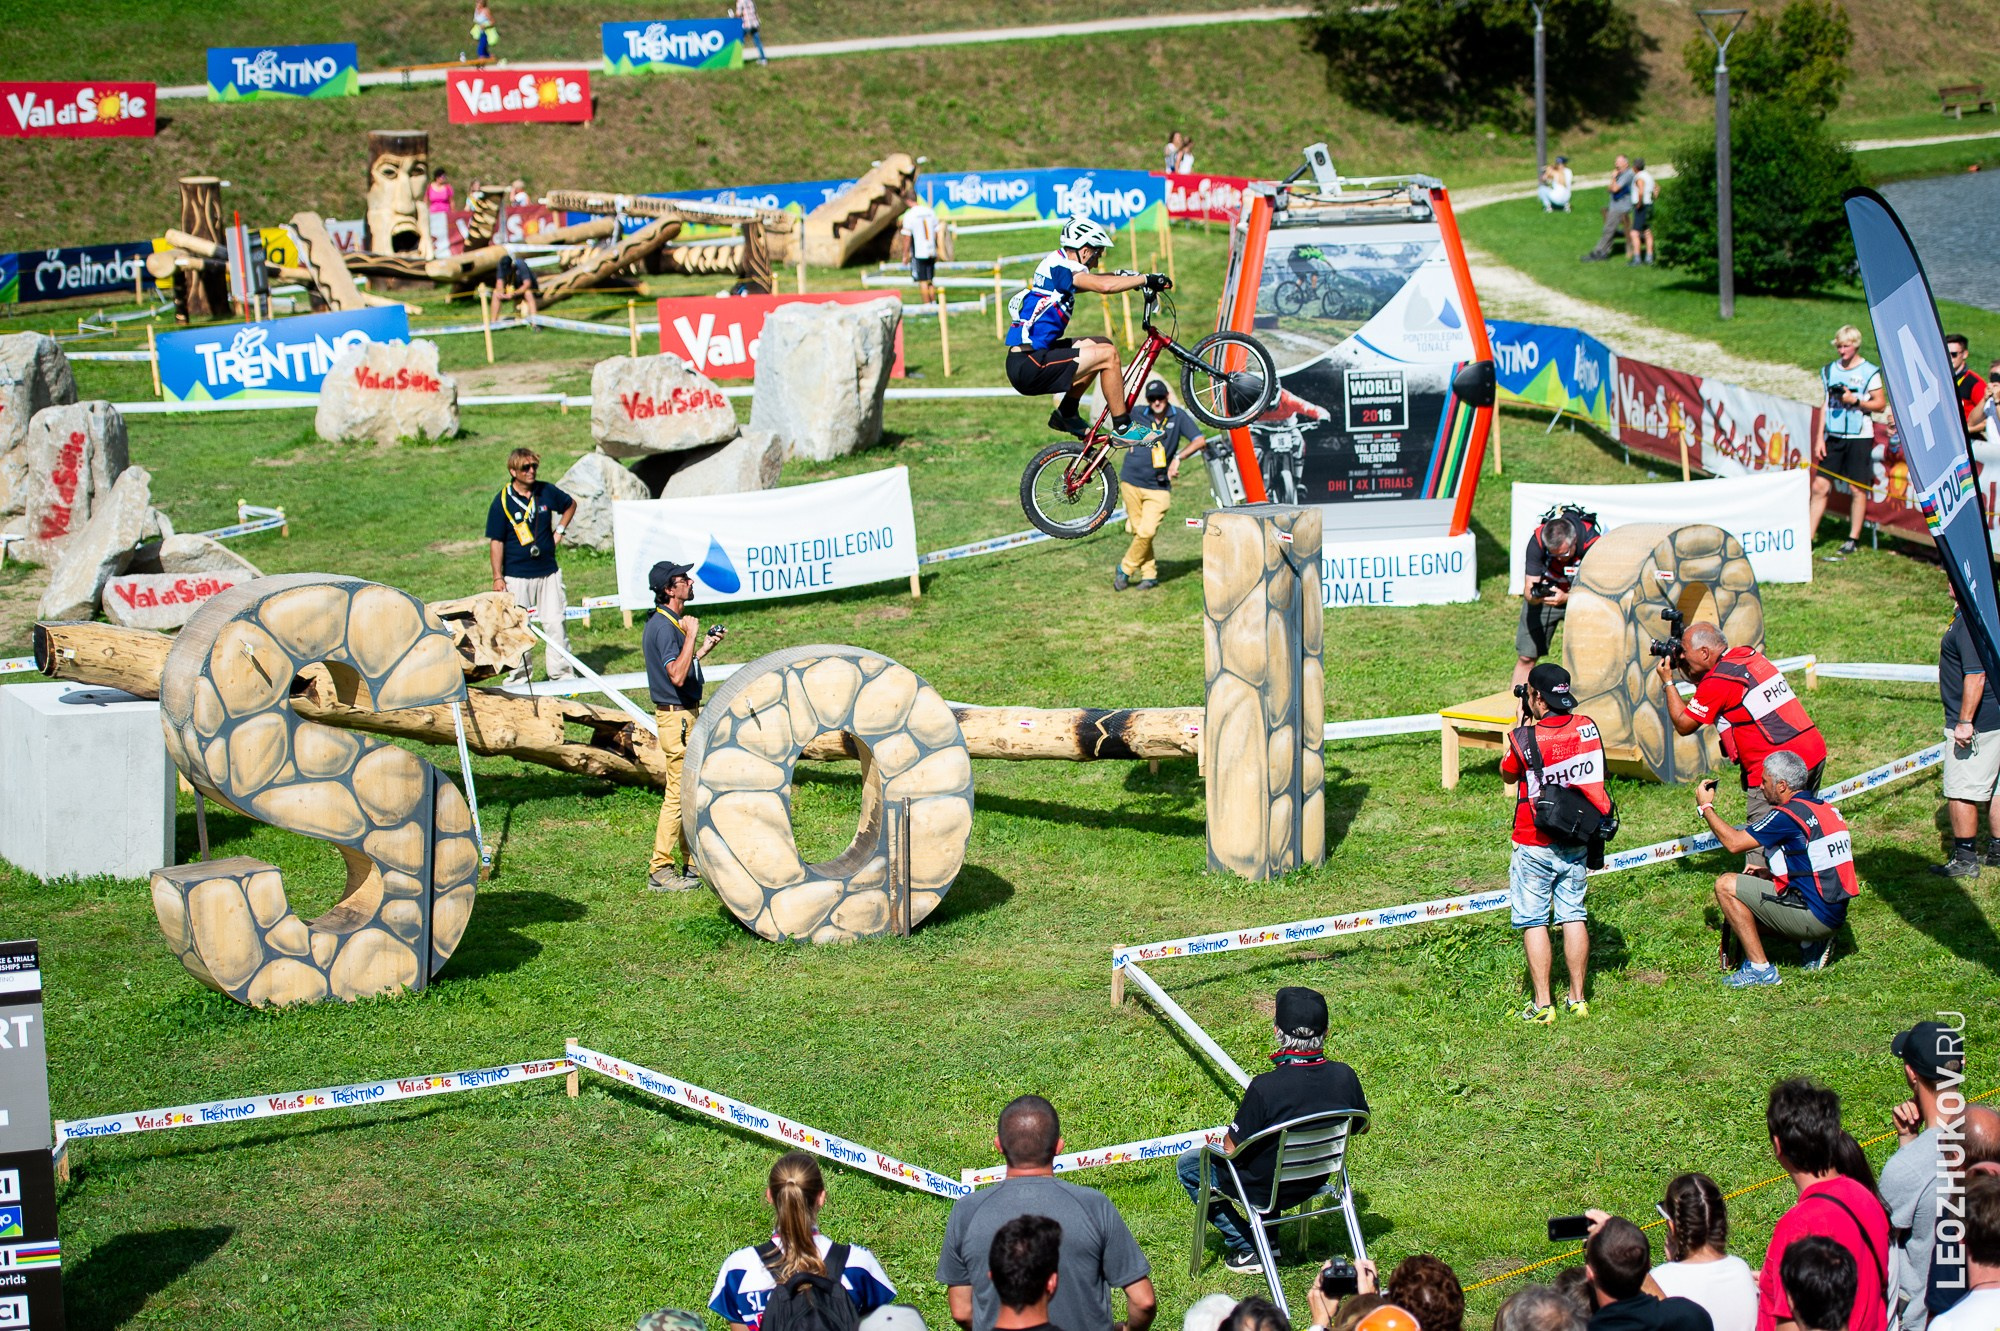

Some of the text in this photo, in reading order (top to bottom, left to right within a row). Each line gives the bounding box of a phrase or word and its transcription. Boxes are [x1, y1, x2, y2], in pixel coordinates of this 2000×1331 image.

[623, 29, 725, 61] TRENTINO
[231, 56, 337, 89] TRENTINO
[6, 87, 147, 131] Val di Sole
[455, 74, 582, 116] Val di Sole
[945, 178, 1029, 205] TRENTINO
[1053, 183, 1147, 220] TRENTINO
[673, 312, 747, 372] Val
[355, 366, 379, 390] Val
[396, 367, 441, 392] Sole
[1350, 379, 1402, 396] WORLD
[620, 391, 655, 421] Val
[671, 386, 727, 415] Sole
[1619, 372, 1645, 426] Val
[1362, 408, 1392, 422] 2016
[1354, 443, 1369, 454] VAL
[1380, 441, 1401, 453] SOLE
[1358, 453, 1397, 464] TRENTINO
[1328, 476, 1414, 492] DHI 4X TRIALS
[747, 526, 893, 568] PONTEDILEGNO
[749, 562, 833, 593] TONALE
[1322, 550, 1463, 580] ONTEDILEGNO
[114, 583, 159, 609] Val
[1322, 581, 1394, 605] ONALE
[1762, 680, 1788, 702] PHO
[1614, 853, 1648, 869] TRENTINO
[1161, 945, 1182, 957] Sole
[1188, 937, 1229, 954] TRENTINO
[1238, 933, 1251, 946] Val
[1259, 930, 1280, 943] Sole
[1285, 923, 1325, 941] TRENTINO
[1334, 919, 1348, 932] Val
[1353, 917, 1374, 929] Sole
[1379, 909, 1417, 926] TRENTINO
[1445, 903, 1464, 914] Sole
[1469, 894, 1507, 911] TRENTINO
[13, 955, 35, 963] TRIALS
[135, 1115, 154, 1130] Val
[155, 1120, 164, 1128] di
[165, 1112, 193, 1127] Sole
[200, 1103, 255, 1122] TRENTINO
[268, 1098, 287, 1111] Val
[288, 1101, 296, 1109] di
[297, 1094, 325, 1109] Sole
[331, 1085, 385, 1104] TRENTINO
[397, 1080, 414, 1093] Val
[425, 1077, 452, 1091] Sole
[457, 1067, 510, 1087] TRENTINO
[522, 1064, 538, 1075] Val
[613, 1063, 634, 1081] Sole
[637, 1072, 676, 1095] TRENTINO
[684, 1087, 698, 1104] Val
[704, 1095, 725, 1114] Sole
[728, 1104, 769, 1129] TRENTINO
[777, 1120, 792, 1138] Val
[799, 1129, 820, 1149] Sole
[825, 1138, 867, 1164] TRENTINO
[876, 1154, 891, 1173] Val
[898, 1163, 921, 1183] Sole
[925, 1172, 972, 1195] TRENTINO
[1076, 1156, 1093, 1168] Val
[1104, 1151, 1132, 1164] Sole
[1139, 1139, 1192, 1159] TRENTINO
